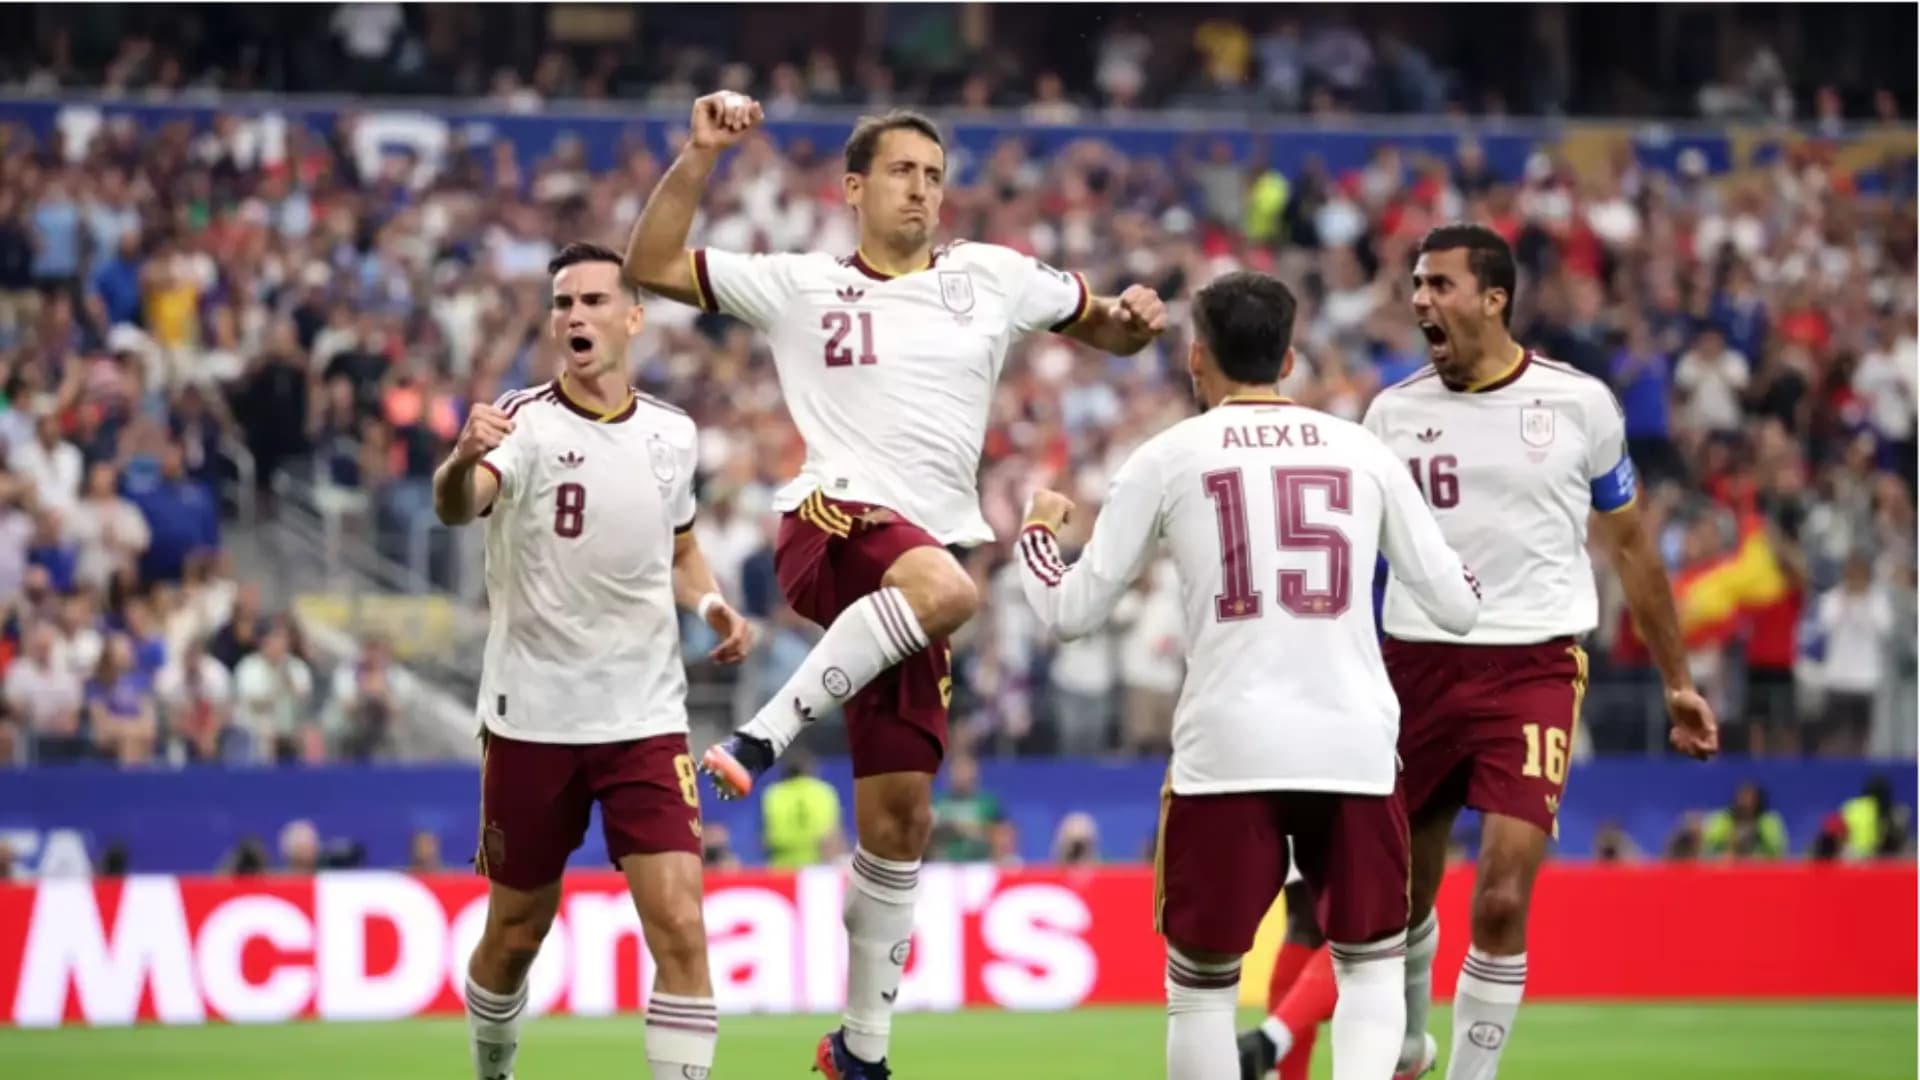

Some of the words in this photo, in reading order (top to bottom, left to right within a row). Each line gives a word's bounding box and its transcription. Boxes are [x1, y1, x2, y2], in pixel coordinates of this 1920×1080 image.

[821, 311, 877, 367] 21
[1221, 424, 1296, 449] ALEX
[1300, 423, 1328, 447] B.
[1408, 453, 1460, 510] 16
[554, 482, 586, 539] 8
[1202, 466, 1353, 624] 15
[673, 753, 699, 808] 8
[1521, 722, 1568, 785] 16
[12, 862, 1099, 1027] McDonald's
